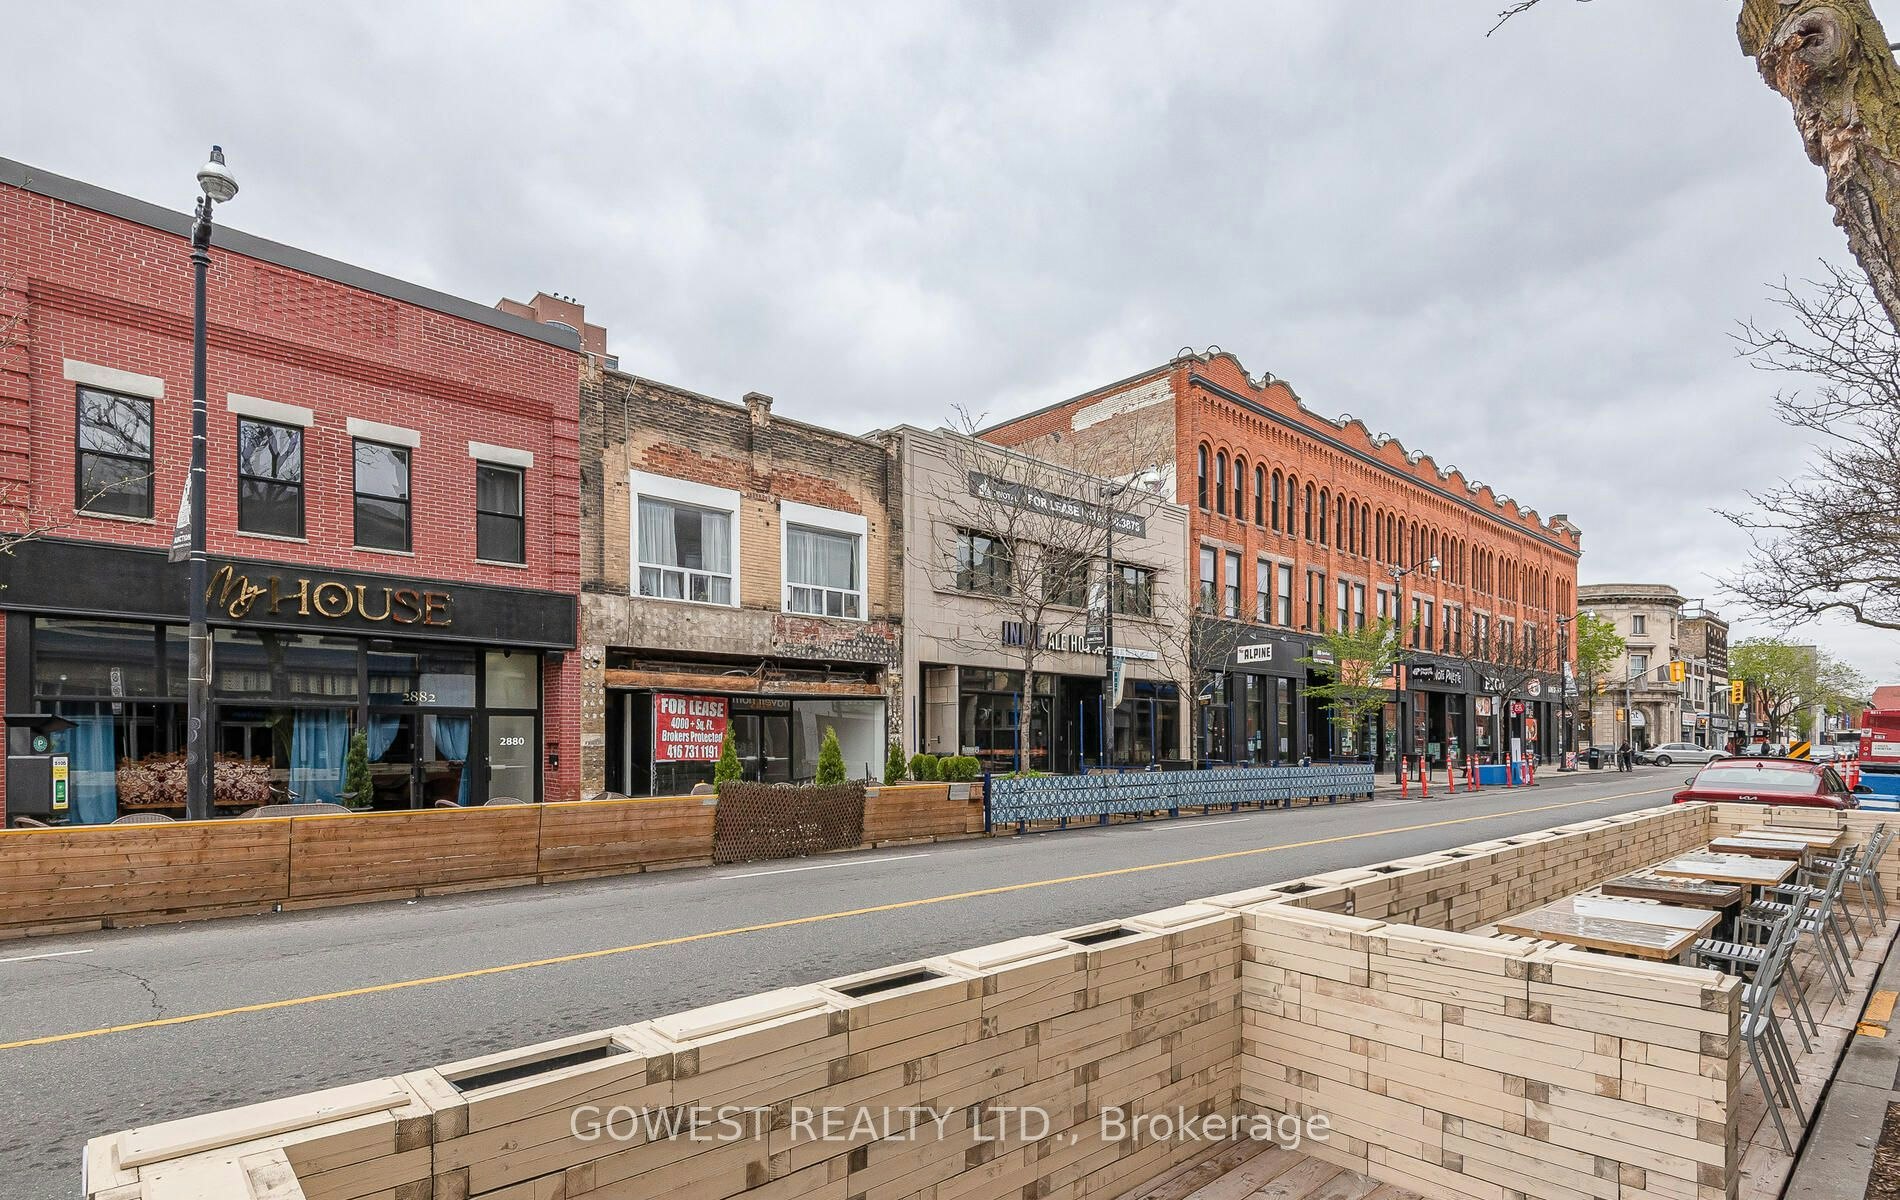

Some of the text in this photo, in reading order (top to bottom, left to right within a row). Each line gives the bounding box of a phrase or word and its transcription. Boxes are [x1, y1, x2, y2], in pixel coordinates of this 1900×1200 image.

[1027, 493, 1048, 509] FOR
[1050, 499, 1080, 518] LEASE
[206, 565, 452, 625] My HOUSE
[1048, 632, 1067, 651] ALE
[1244, 647, 1271, 660] ALPINE
[402, 691, 436, 703] 2882
[661, 697, 724, 718] FOR LEASE
[671, 717, 690, 729] 4000
[695, 718, 706, 731] Sq.
[499, 737, 525, 746] 2880
[661, 730, 723, 743] Brokers Protected
[667, 744, 719, 758] 416 731 1191
